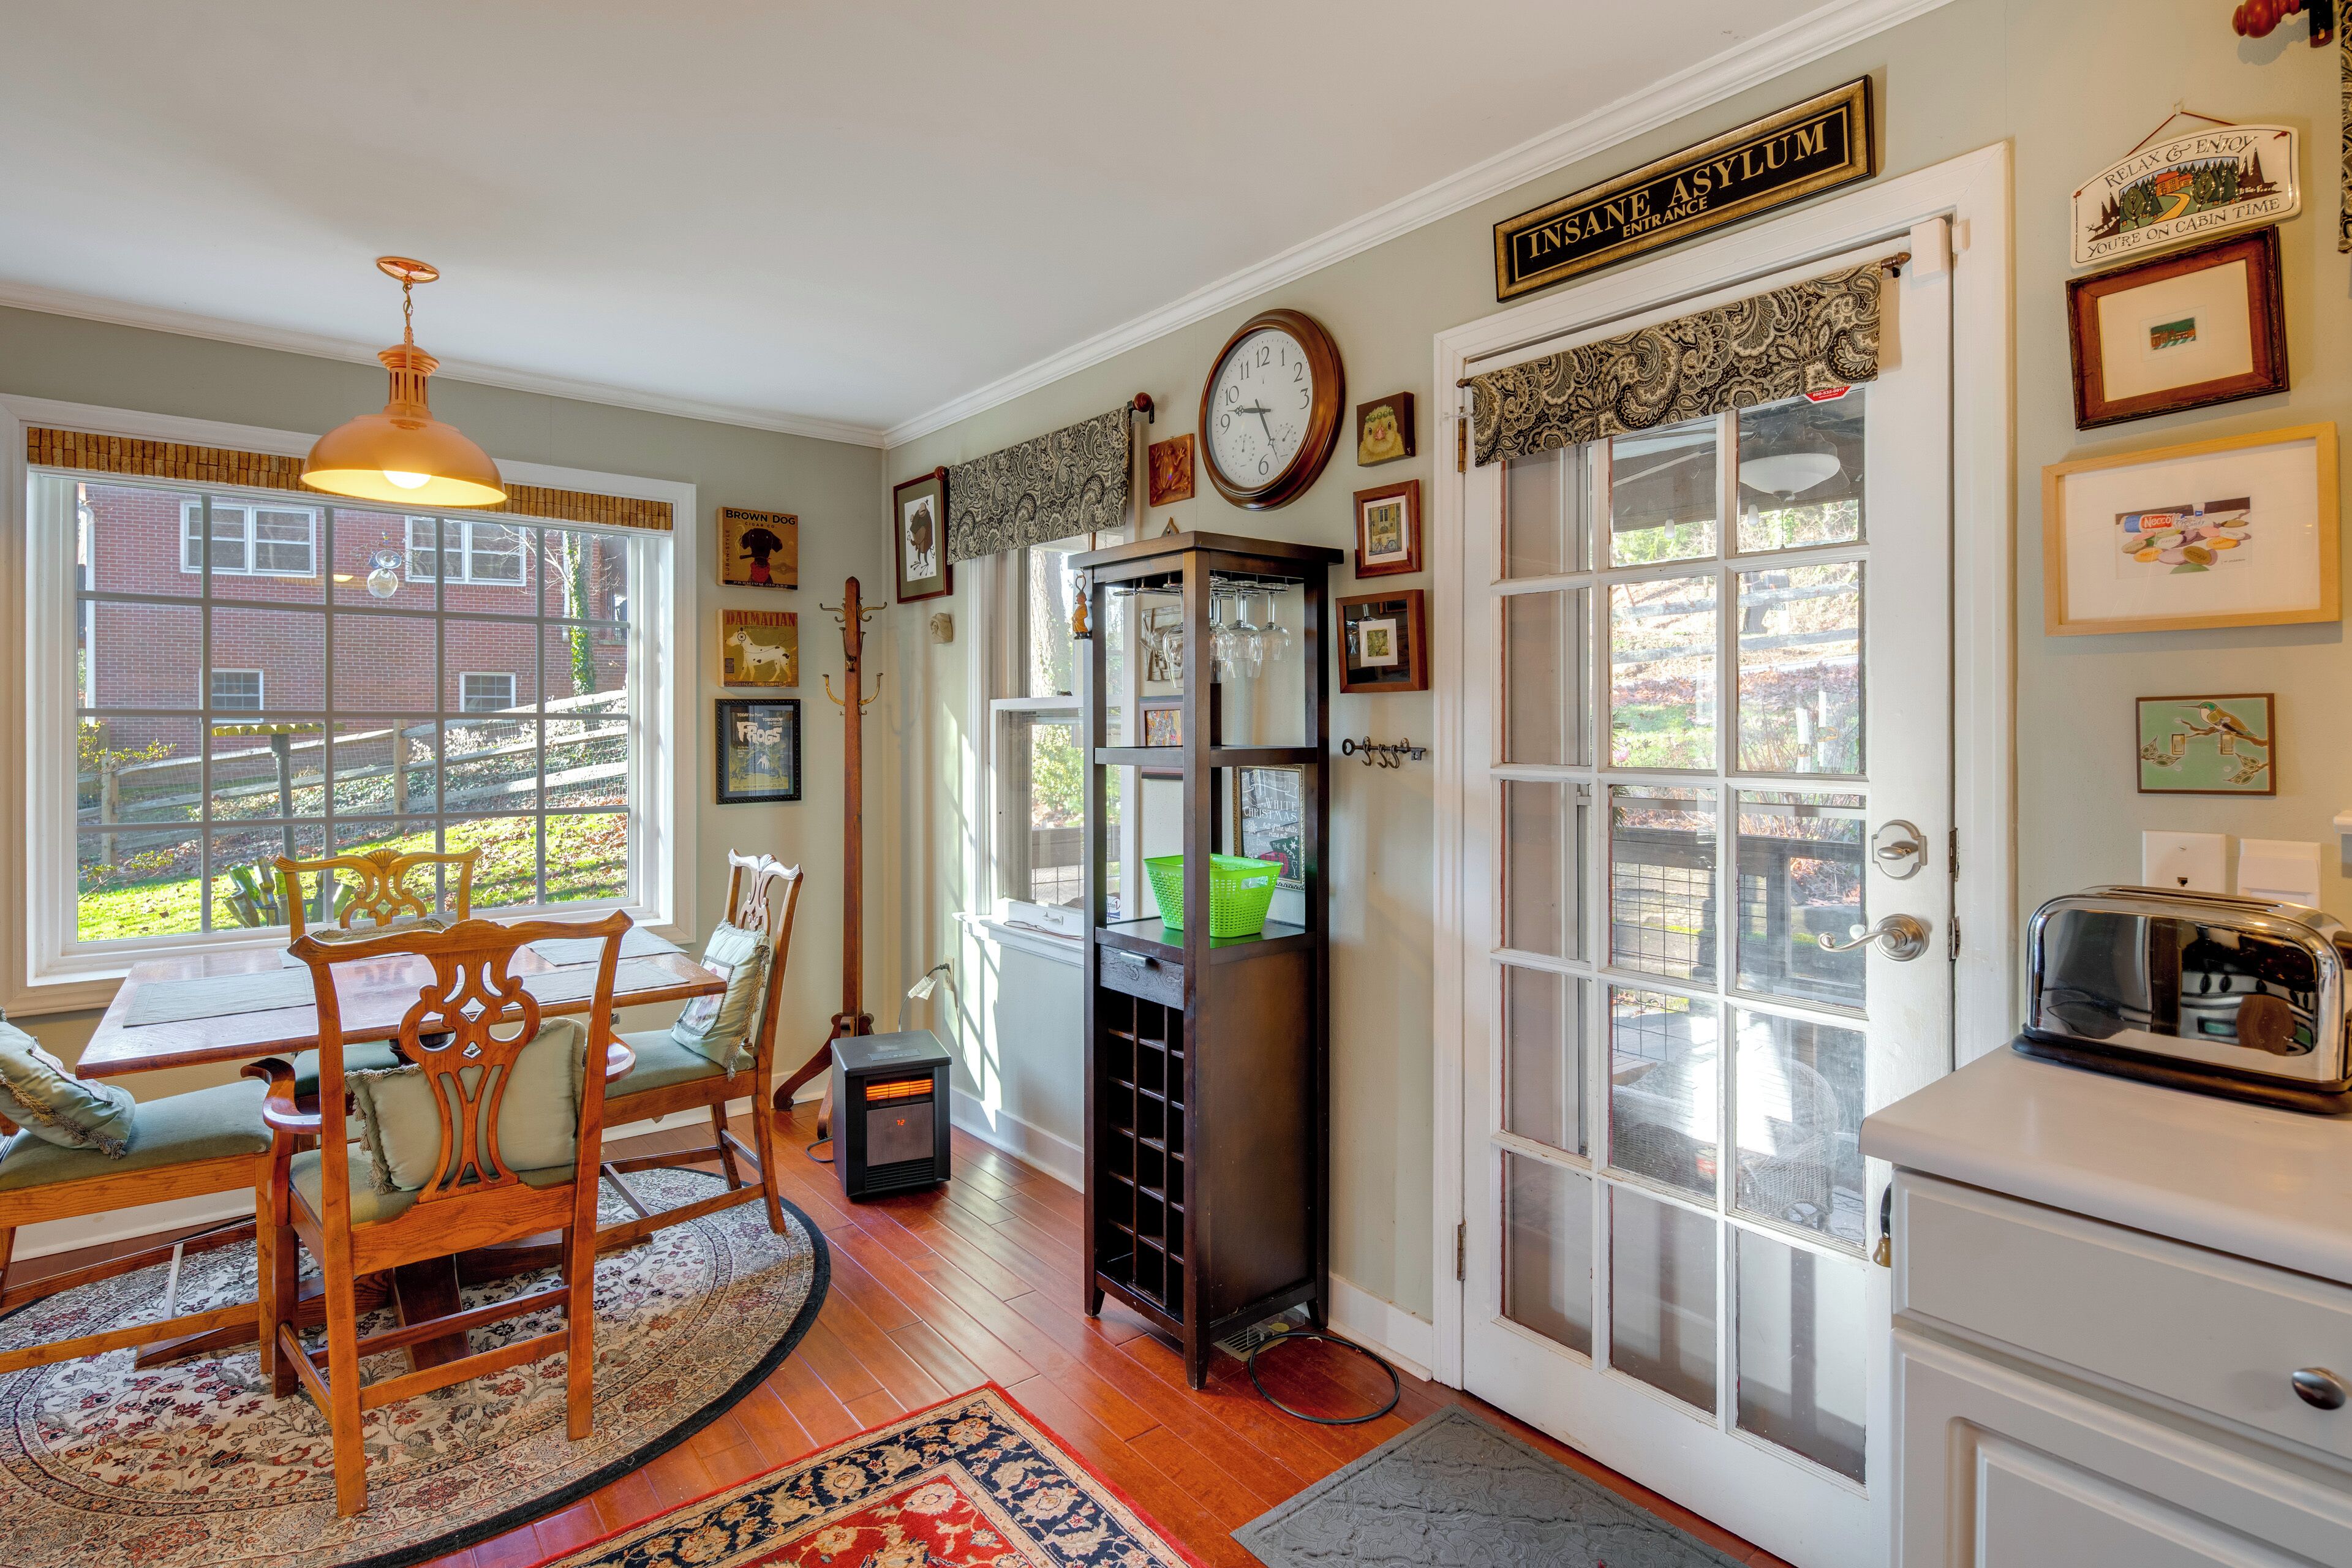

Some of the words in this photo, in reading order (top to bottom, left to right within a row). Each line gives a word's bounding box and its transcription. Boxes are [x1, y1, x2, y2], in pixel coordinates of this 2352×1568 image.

[2103, 151, 2161, 189] RELAX
[2166, 143, 2191, 162] &
[2195, 134, 2258, 154] ENJOY
[1529, 189, 1651, 258] INSANE
[1668, 121, 1827, 208] ASYLUM
[1623, 195, 1708, 238] ENTRANCE
[2087, 232, 2141, 258] YOU'RE
[2146, 224, 2169, 240] ON
[2175, 209, 2226, 233] CABIN
[2233, 198, 2280, 219] TIME
[1256, 346, 1270, 368] 12
[1280, 347, 1286, 366] 1
[1240, 360, 1250, 380] 11
[1294, 361, 1303, 382] 2
[1224, 385, 1240, 405] 10
[1299, 387, 1310, 410] 3
[1220, 413, 1231, 435] 9
[1258, 453, 1270, 475] 6
[726, 509, 768, 522] BROWN
[772, 514, 796, 525] DOG
[2144, 516, 2171, 529] Necco
[725, 611, 796, 627] DALMATIAN
[736, 721, 783, 746] FROGS
[1243, 807, 1298, 822] CHRISTMAS
[1265, 797, 1297, 812] WHITE
[1284, 825, 1298, 834] white
